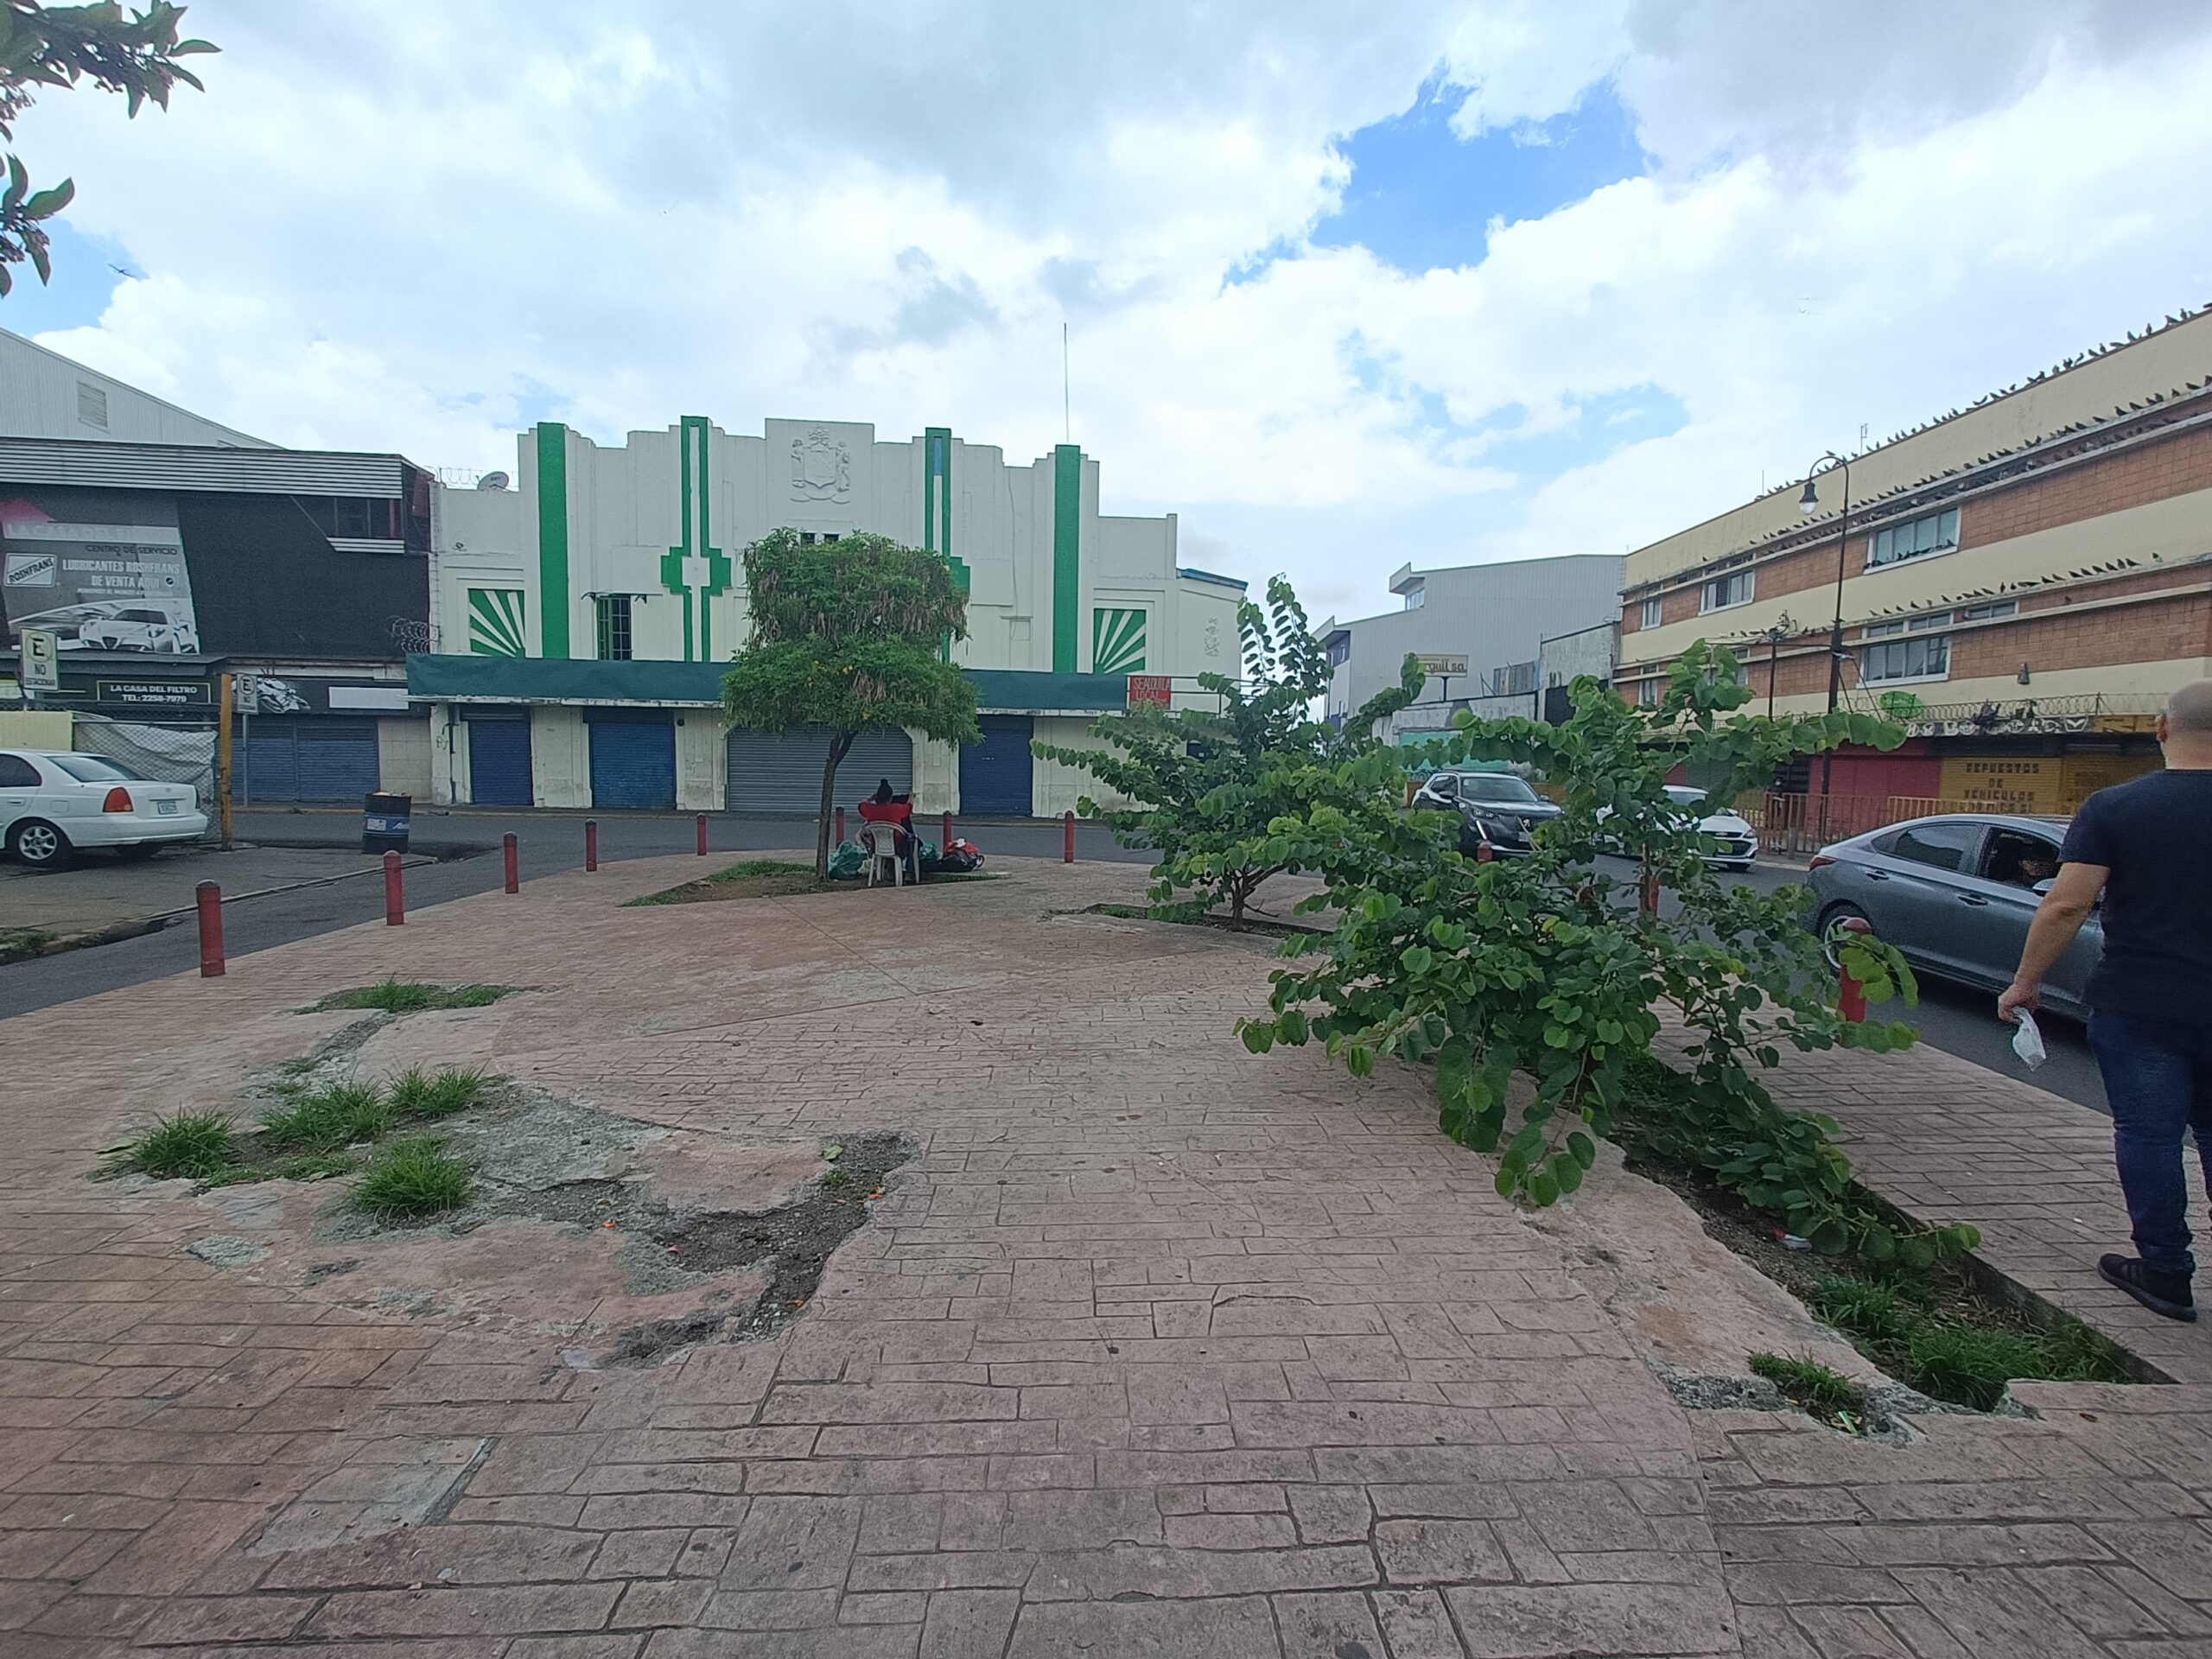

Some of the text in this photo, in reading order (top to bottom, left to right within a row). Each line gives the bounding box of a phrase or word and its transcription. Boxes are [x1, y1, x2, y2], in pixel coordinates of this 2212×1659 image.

[86, 544, 121, 553] CENTRO
[138, 547, 178, 556] SERVICIO
[9, 556, 54, 584] ROSHFRANS
[62, 559, 180, 575] LUBRICANTES ROSHFRANS
[92, 575, 103, 586] DE
[105, 576, 135, 588] VENTA
[32, 637, 46, 657] E
[34, 664, 47, 676] NO
[1135, 690, 1160, 701] LOCAL
[1966, 762, 2040, 774] REPUESTOS
[1989, 778, 2004, 788] DE
